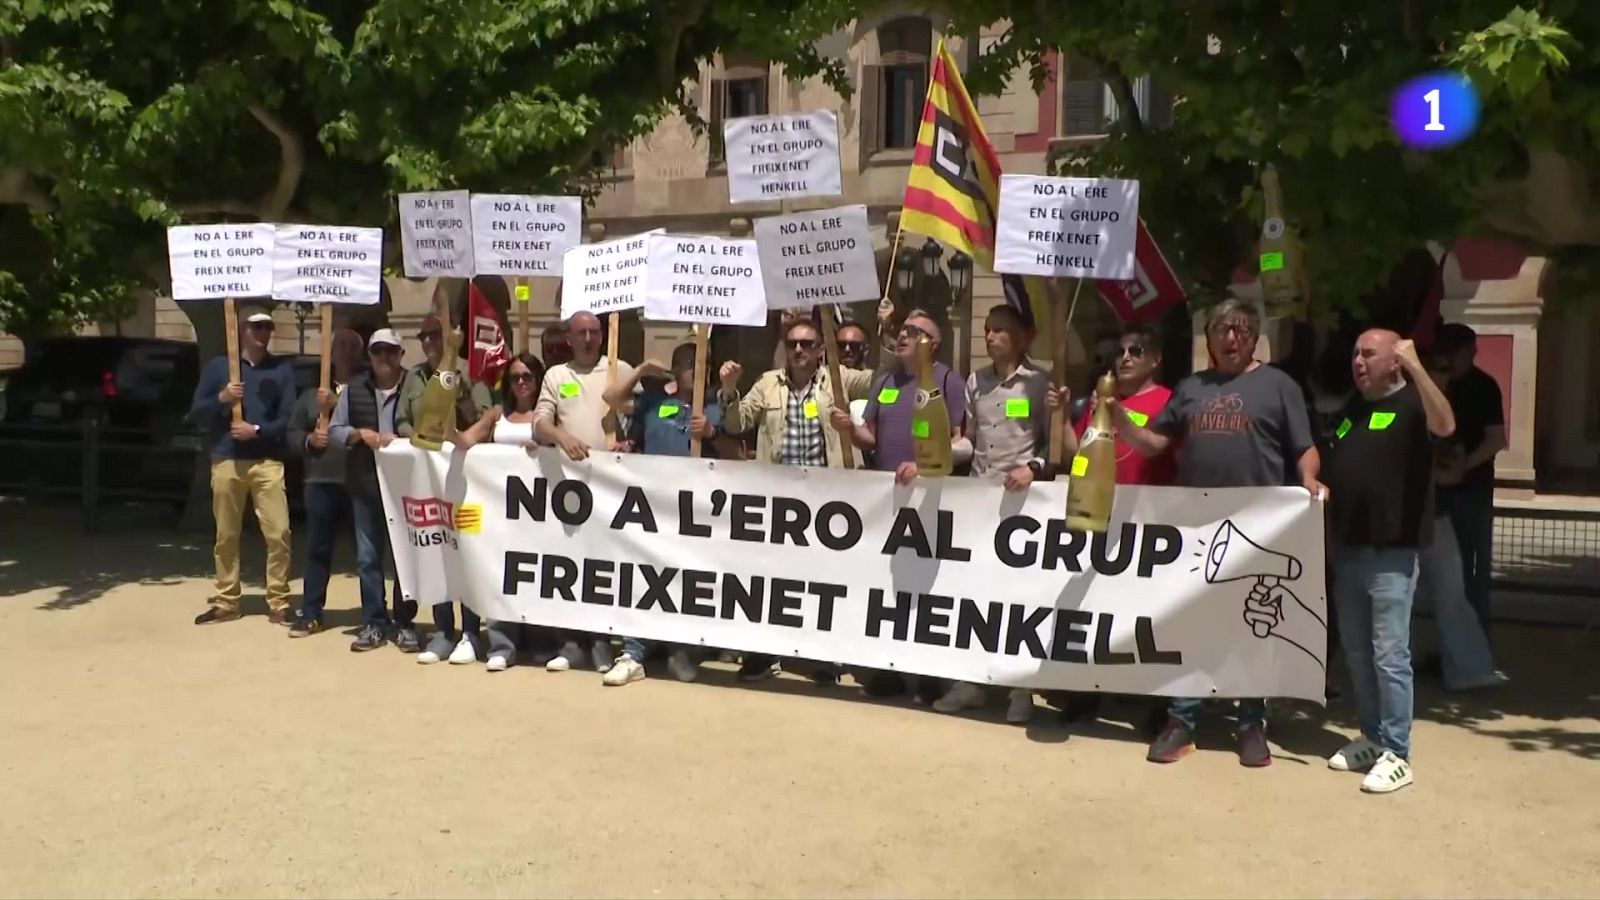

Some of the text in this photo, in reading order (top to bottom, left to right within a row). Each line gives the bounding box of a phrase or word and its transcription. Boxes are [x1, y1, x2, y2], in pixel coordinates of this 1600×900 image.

[750, 122, 767, 134] NO
[791, 119, 812, 131] ERE
[750, 138, 823, 155] EN EL GRUPO
[752, 160, 810, 175] FREIXENET
[1033, 183, 1055, 196] NO
[1084, 186, 1109, 199] ERE
[414, 200, 426, 208] NO
[442, 200, 454, 209] ERE
[494, 203, 511, 212] NO
[536, 203, 556, 213] ERE
[1029, 207, 1119, 224] EN EL GRUPO
[415, 220, 462, 230] EN EL GRUPO
[492, 221, 565, 232] EN EL GRUPO
[780, 223, 797, 235] NO
[822, 217, 843, 230] ERE
[194, 232, 211, 241] NO
[235, 231, 253, 240] ERE
[300, 231, 316, 240] NO
[339, 233, 358, 243] ERE
[194, 248, 264, 258] EN EL GRUPO
[298, 249, 367, 261] EN EL GRUPO
[588, 246, 603, 258] NO
[626, 240, 645, 252] ERE
[677, 243, 695, 255] NO
[722, 245, 744, 257] ERE
[781, 238, 856, 257] EN EL GRUPO
[585, 265, 598, 276] EN
[601, 263, 611, 273] EL
[673, 263, 753, 278] EN EL GRUPO
[506, 475, 1183, 578] NO A L’ERO AL GRUP
[503, 550, 1182, 666] FREIXENET HENKELL
